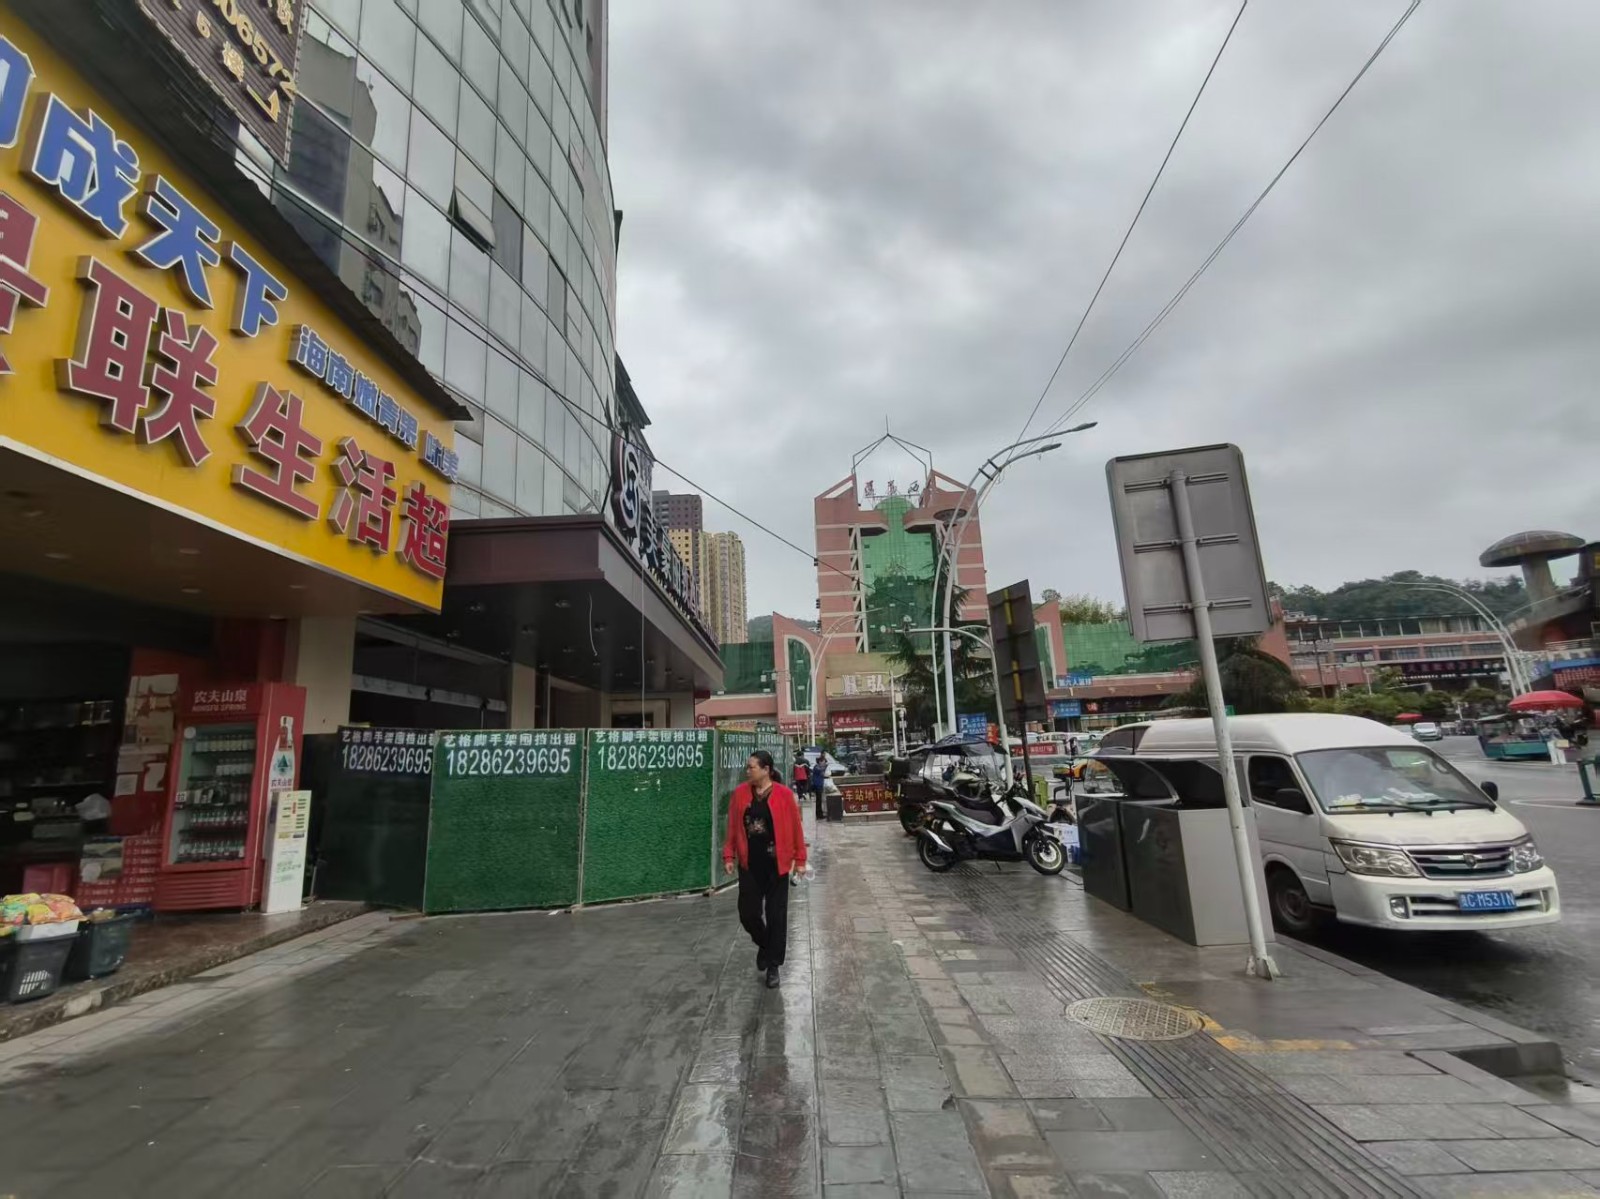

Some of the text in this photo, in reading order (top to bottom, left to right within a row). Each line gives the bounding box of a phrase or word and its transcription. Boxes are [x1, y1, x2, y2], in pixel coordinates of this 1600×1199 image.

[194, 689, 247, 703] 农夫山泉
[342, 745, 431, 774] 18286239695
[447, 748, 570, 775] 18286239695
[598, 745, 703, 770] 18286239695
